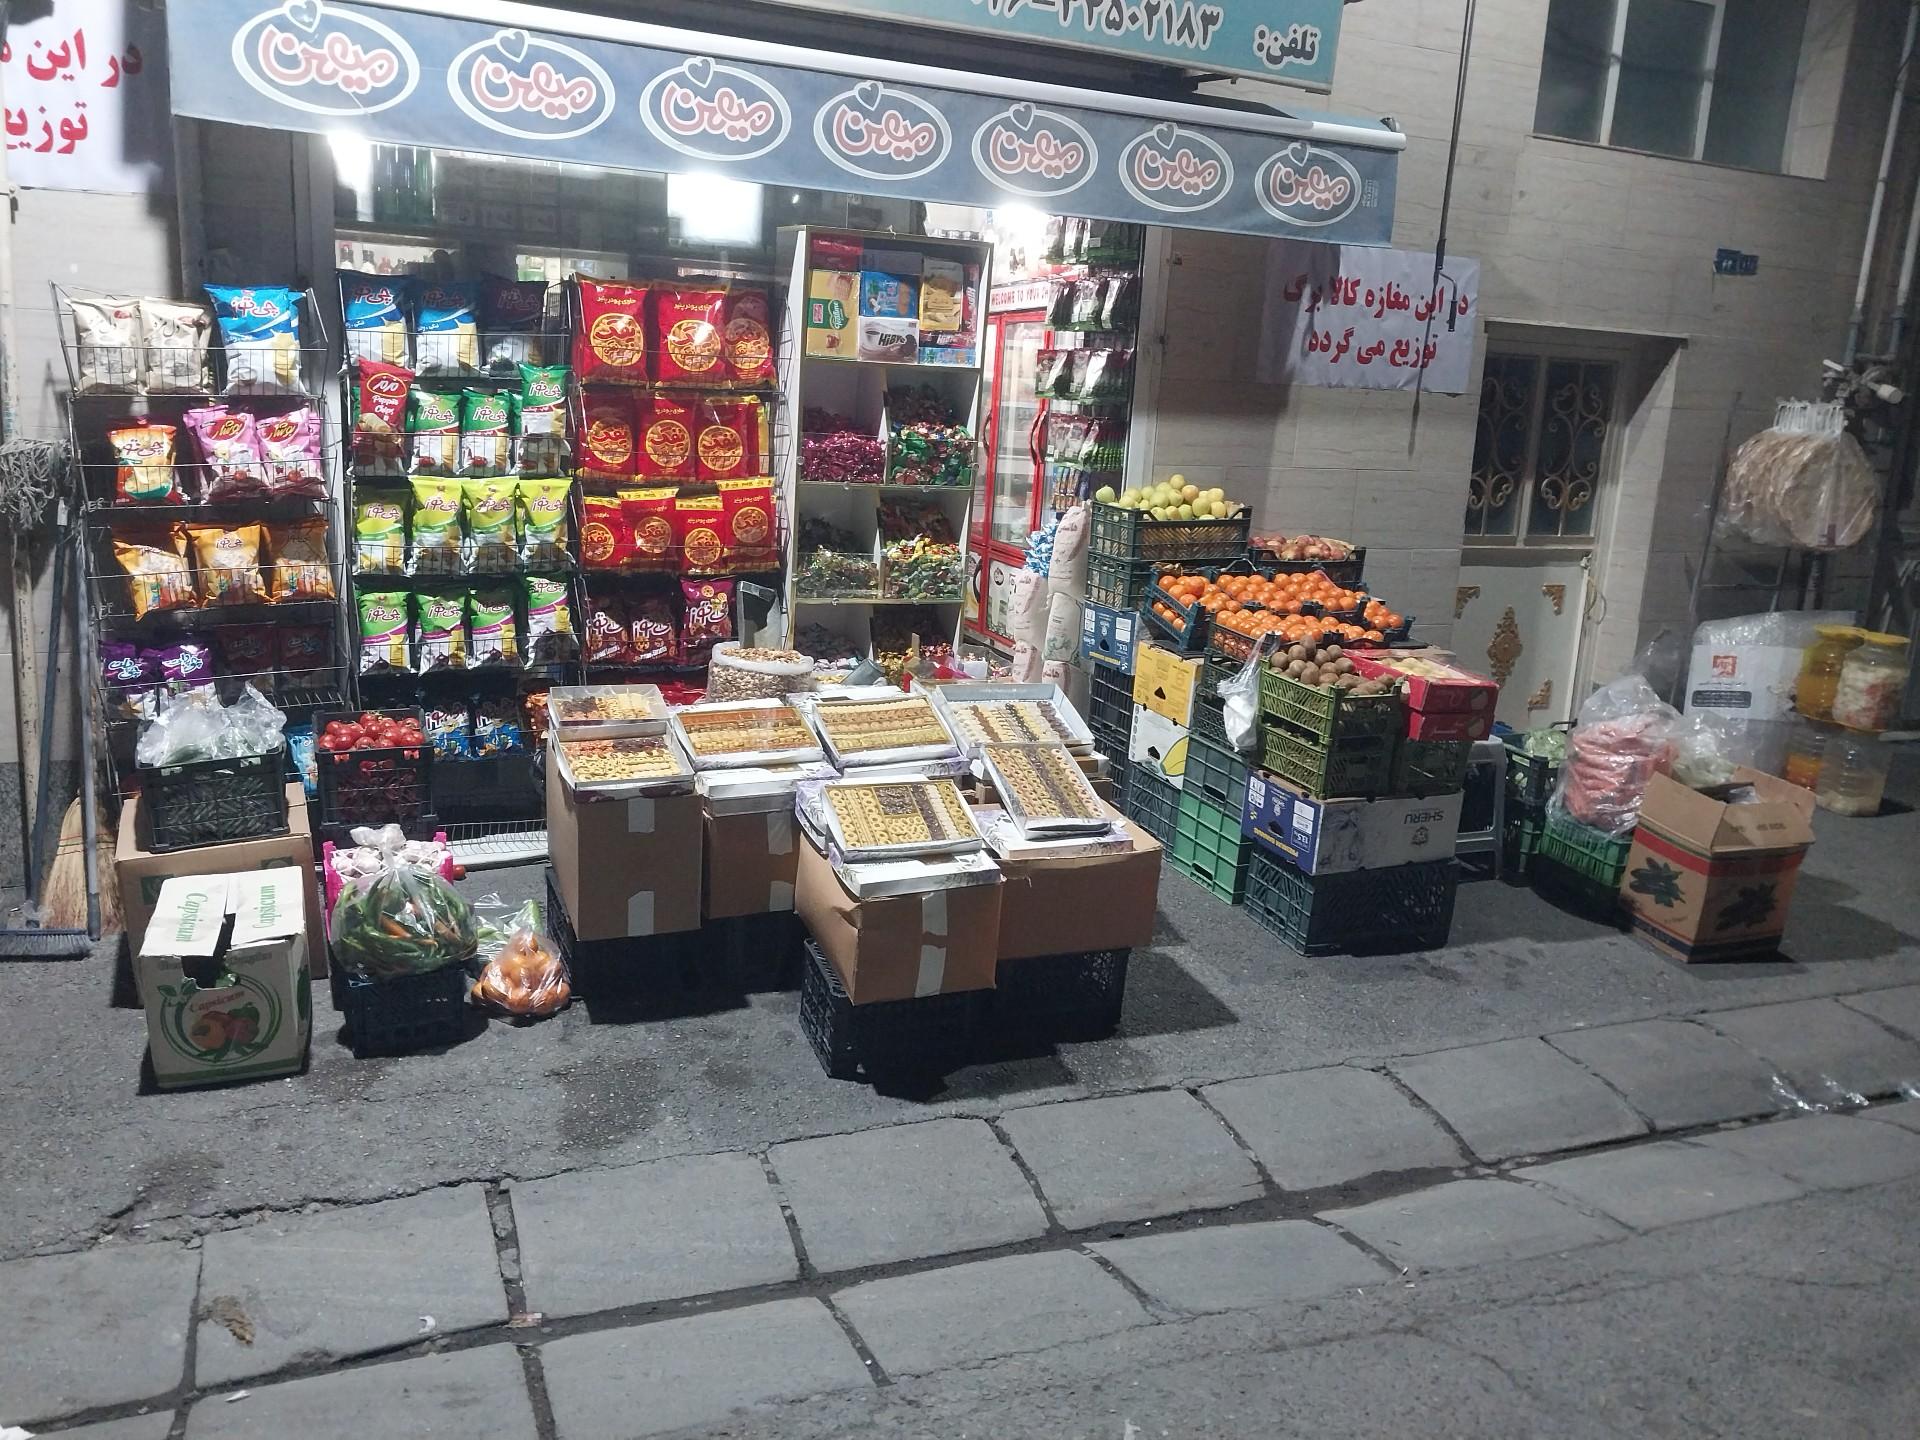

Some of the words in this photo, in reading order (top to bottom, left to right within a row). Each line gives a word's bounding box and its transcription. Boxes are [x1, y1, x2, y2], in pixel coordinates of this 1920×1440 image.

[26, 28, 87, 81] این
[100, 41, 143, 88] در
[259, 24, 398, 94] میهن
[1257, 28, 1317, 66] تلفن:
[471, 54, 596, 120] میهن
[661, 81, 774, 142] میهن
[3, 101, 88, 154] توزی
[833, 104, 936, 162] میهن
[989, 125, 1084, 179] میهن
[1134, 144, 1221, 195] میهن
[1270, 161, 1350, 210] میهن
[1365, 282, 1410, 318] مغازه
[1308, 327, 1354, 364] گردد
[1356, 339, 1385, 365] می
[1390, 334, 1438, 369] توزیع
[1403, 809, 1444, 825] SHERU
[176, 892, 208, 942] Capsicum
[252, 885, 283, 929] Capsicum
